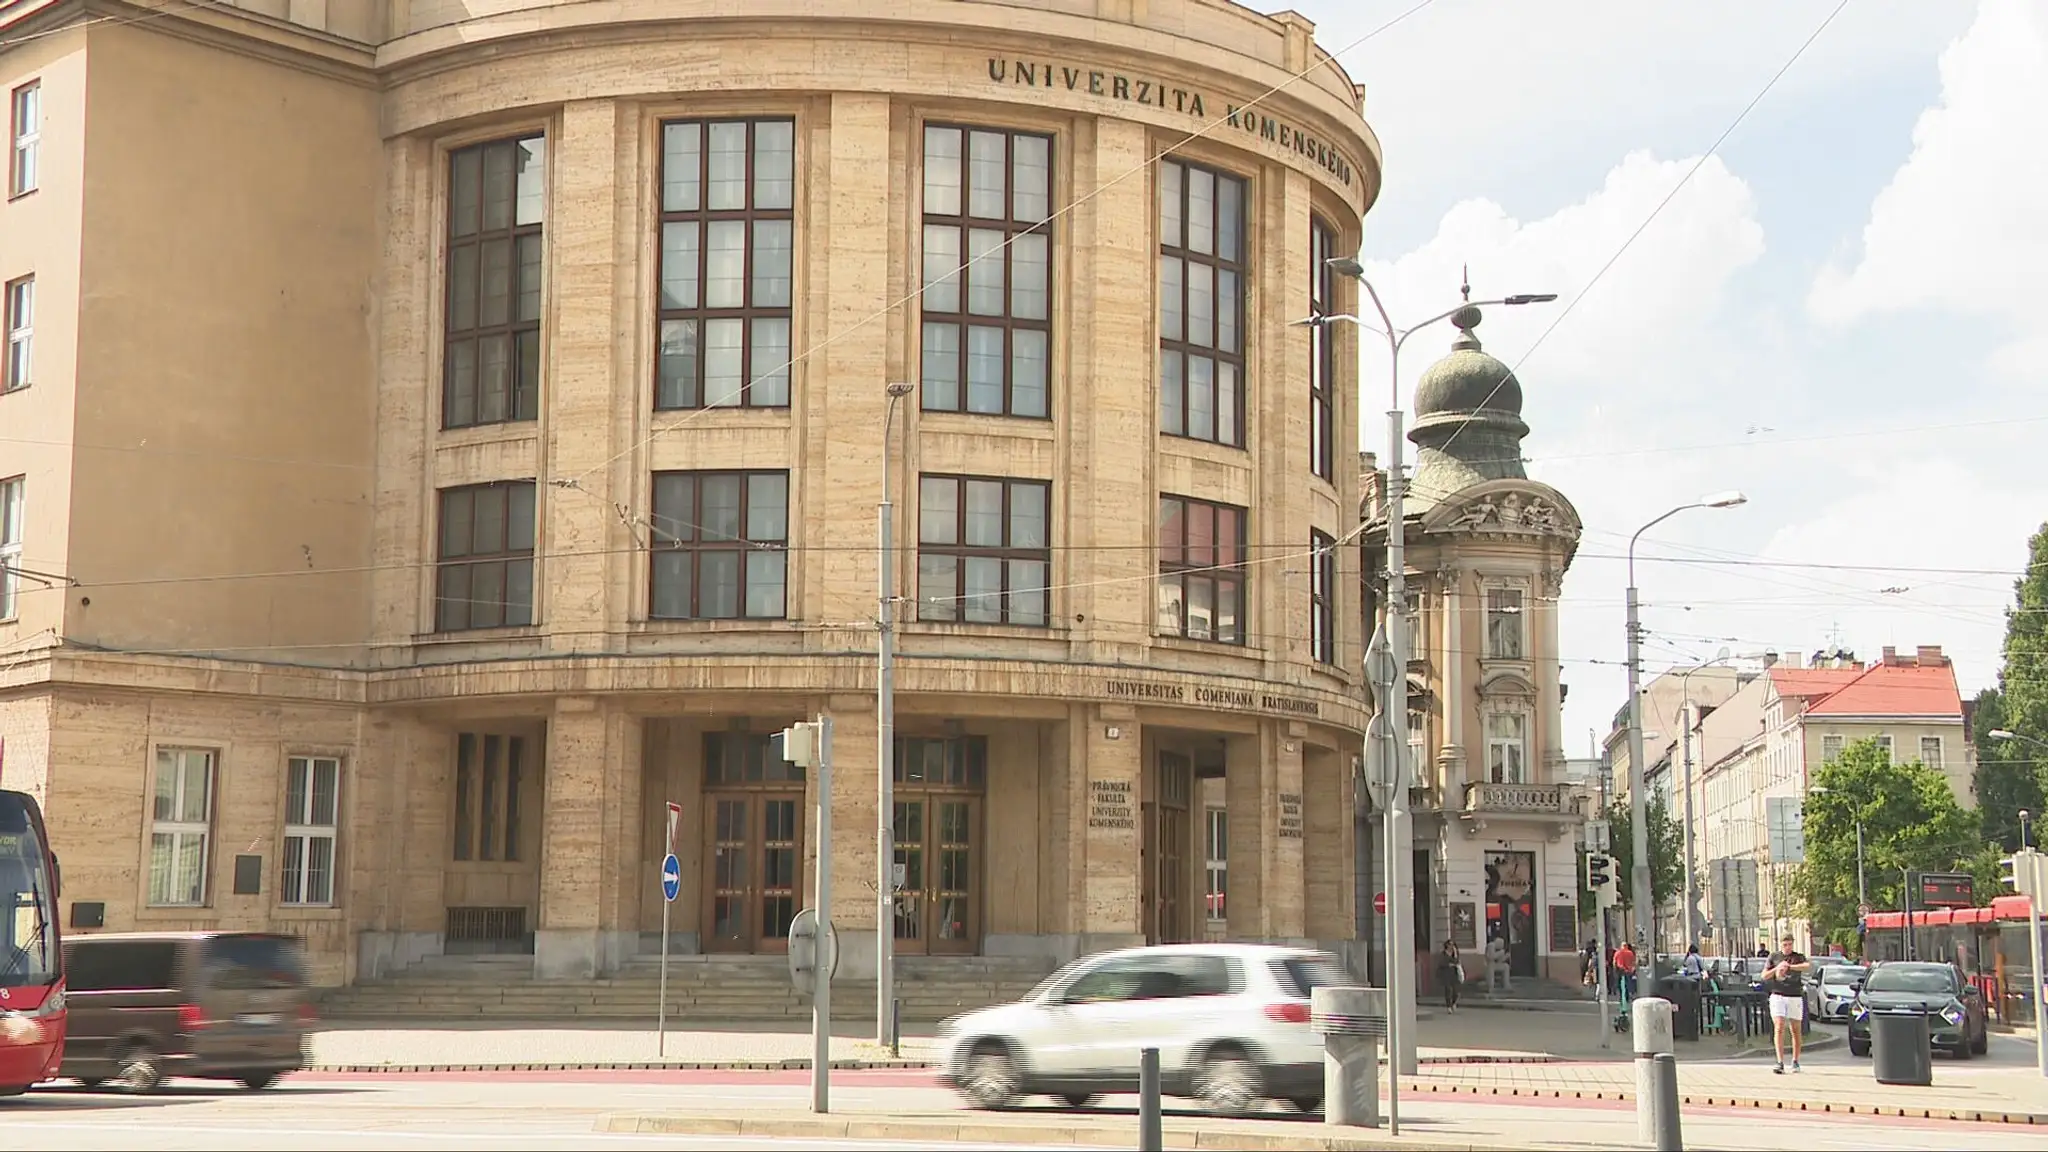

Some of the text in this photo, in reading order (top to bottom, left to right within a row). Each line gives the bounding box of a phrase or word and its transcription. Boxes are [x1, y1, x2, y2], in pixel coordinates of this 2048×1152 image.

[988, 58, 1351, 187] UNIVERZITA KOMENSKÉHO
[1107, 681, 1184, 699] UNIVERSITAS
[1194, 687, 1254, 706] COMENIANA
